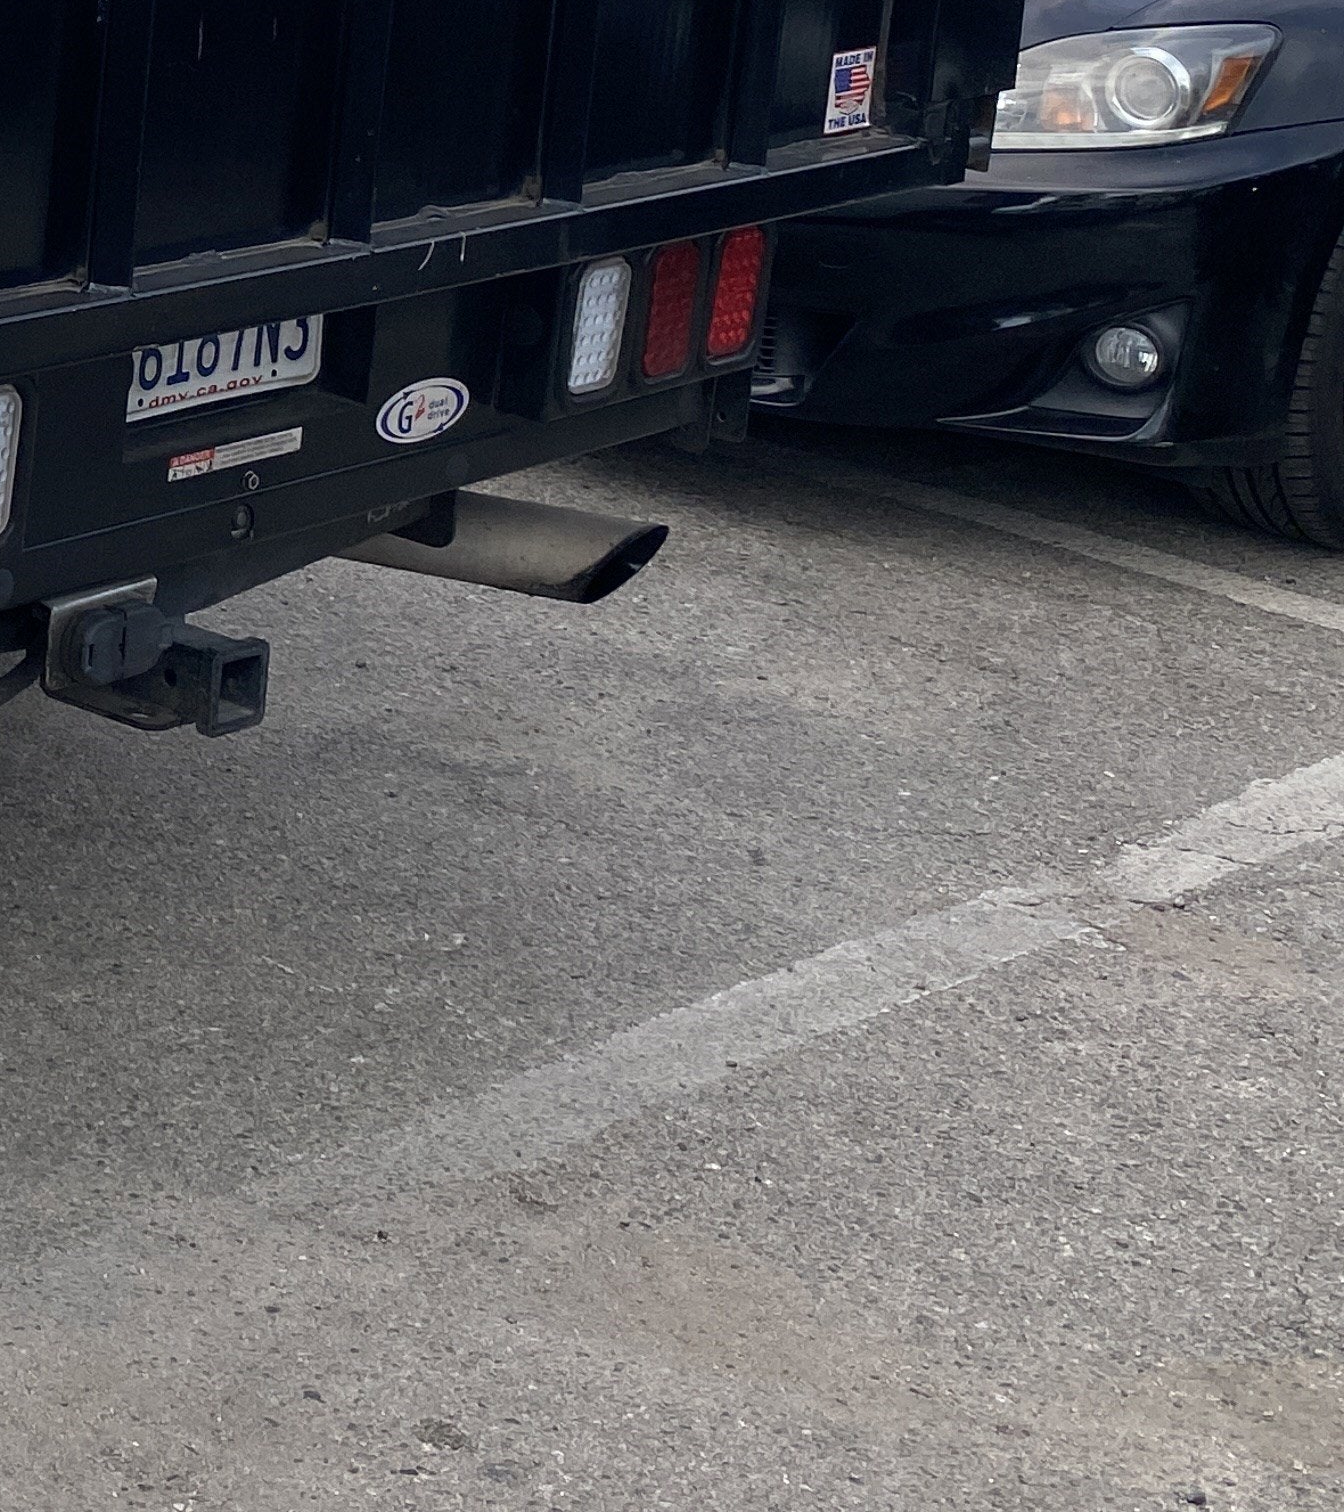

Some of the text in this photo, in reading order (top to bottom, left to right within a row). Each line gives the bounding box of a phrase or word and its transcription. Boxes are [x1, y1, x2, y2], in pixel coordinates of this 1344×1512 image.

[835, 50, 875, 67] MADE IN
[828, 112, 867, 129] THE USA
[148, 374, 263, 409] dmv.ca.gov
[428, 395, 448, 410] dual
[427, 408, 450, 420] drive
